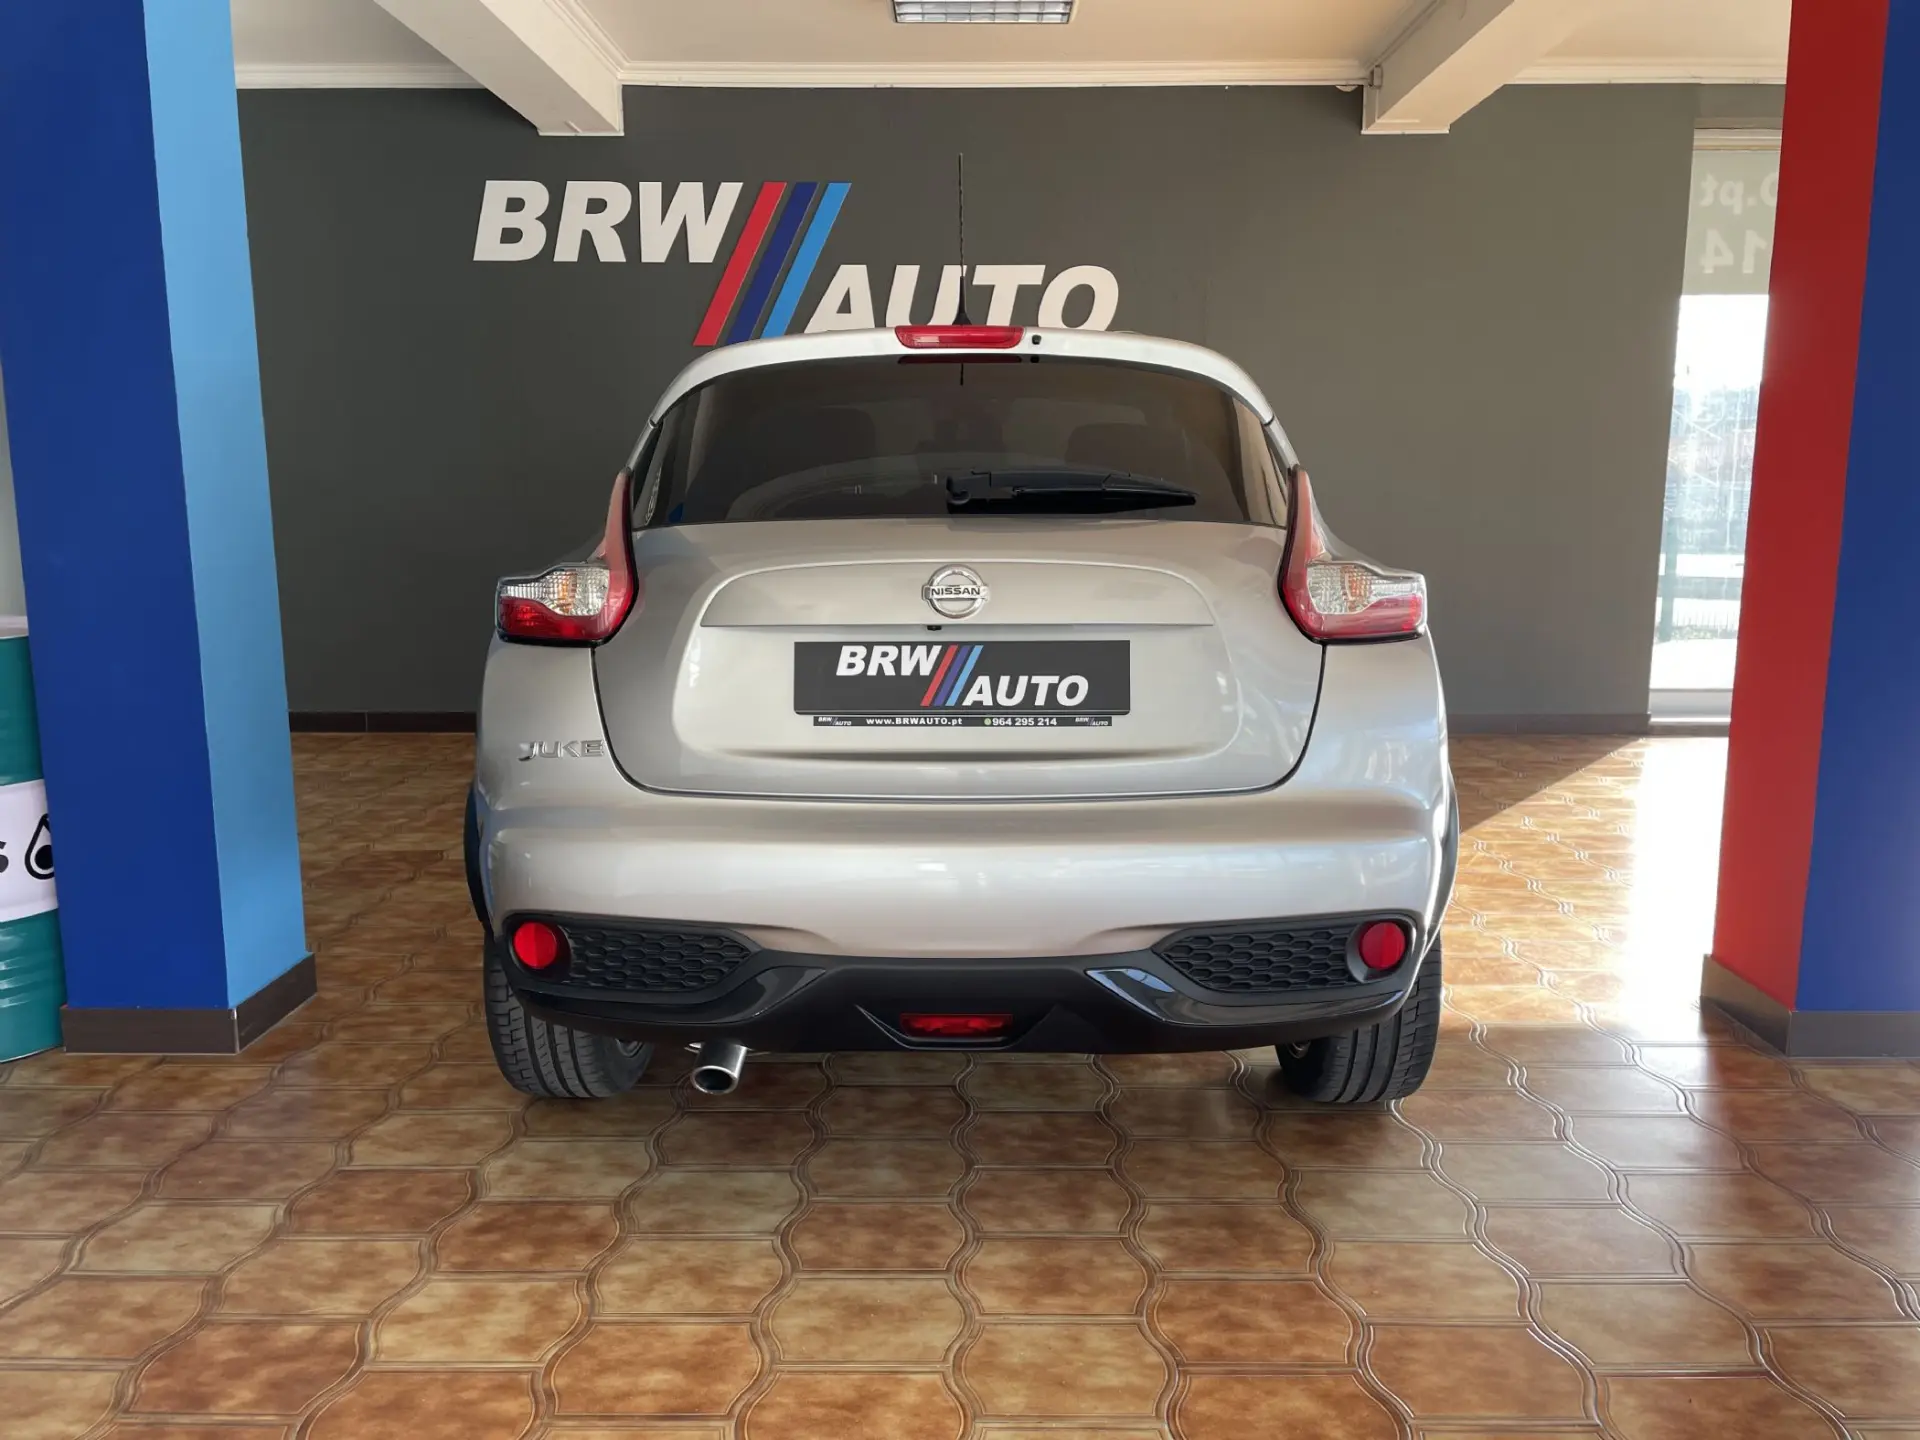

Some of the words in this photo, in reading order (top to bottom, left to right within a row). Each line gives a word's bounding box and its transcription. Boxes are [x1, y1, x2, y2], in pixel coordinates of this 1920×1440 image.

[473, 180, 744, 263] BRW
[803, 264, 1120, 334] AUTO
[931, 587, 980, 595] NISSAN
[836, 645, 942, 676] BRW
[962, 675, 1089, 706] AUTO
[866, 717, 962, 726] www.BRWAUTO.pt
[992, 717, 1012, 726] 964
[1015, 717, 1034, 726] 295
[1038, 717, 1057, 726] 214
[518, 740, 604, 761] JUKE
